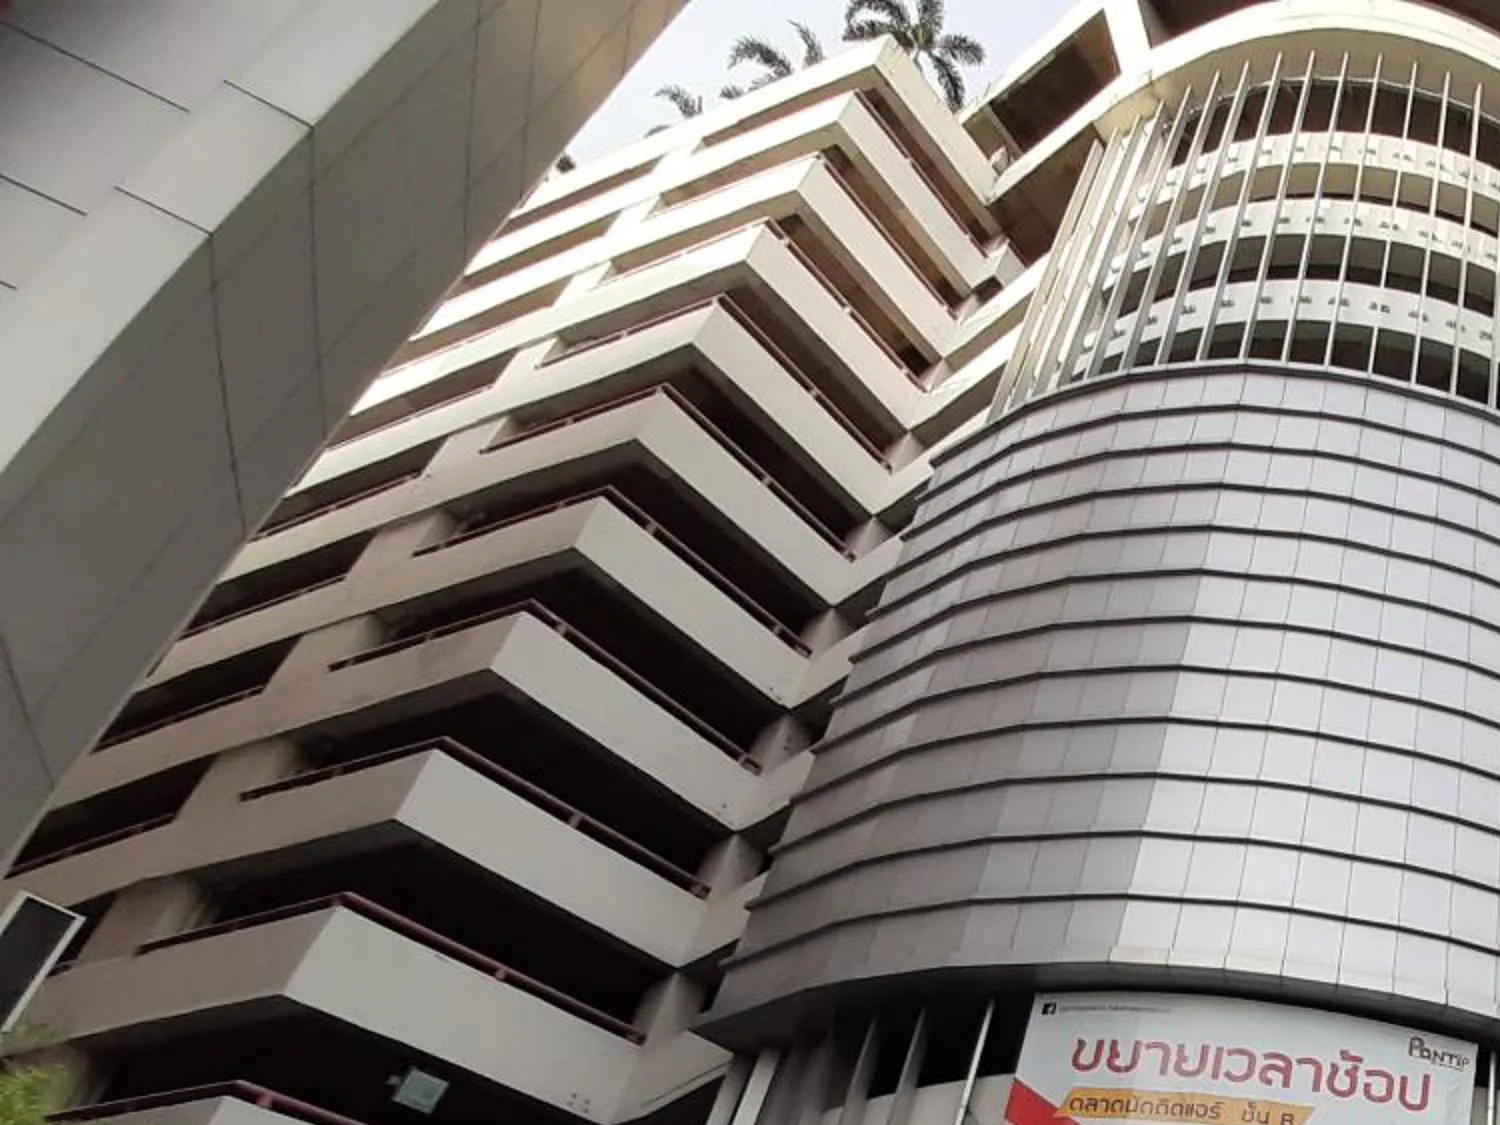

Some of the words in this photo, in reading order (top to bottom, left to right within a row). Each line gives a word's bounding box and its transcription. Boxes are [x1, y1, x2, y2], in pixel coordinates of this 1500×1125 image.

[1071, 1037, 1431, 1111] ขยายเวลาช้อป
[1069, 1095, 1223, 1121] ตลาดนัดติดแอร์
[1241, 1101, 1271, 1125] ชั้น
